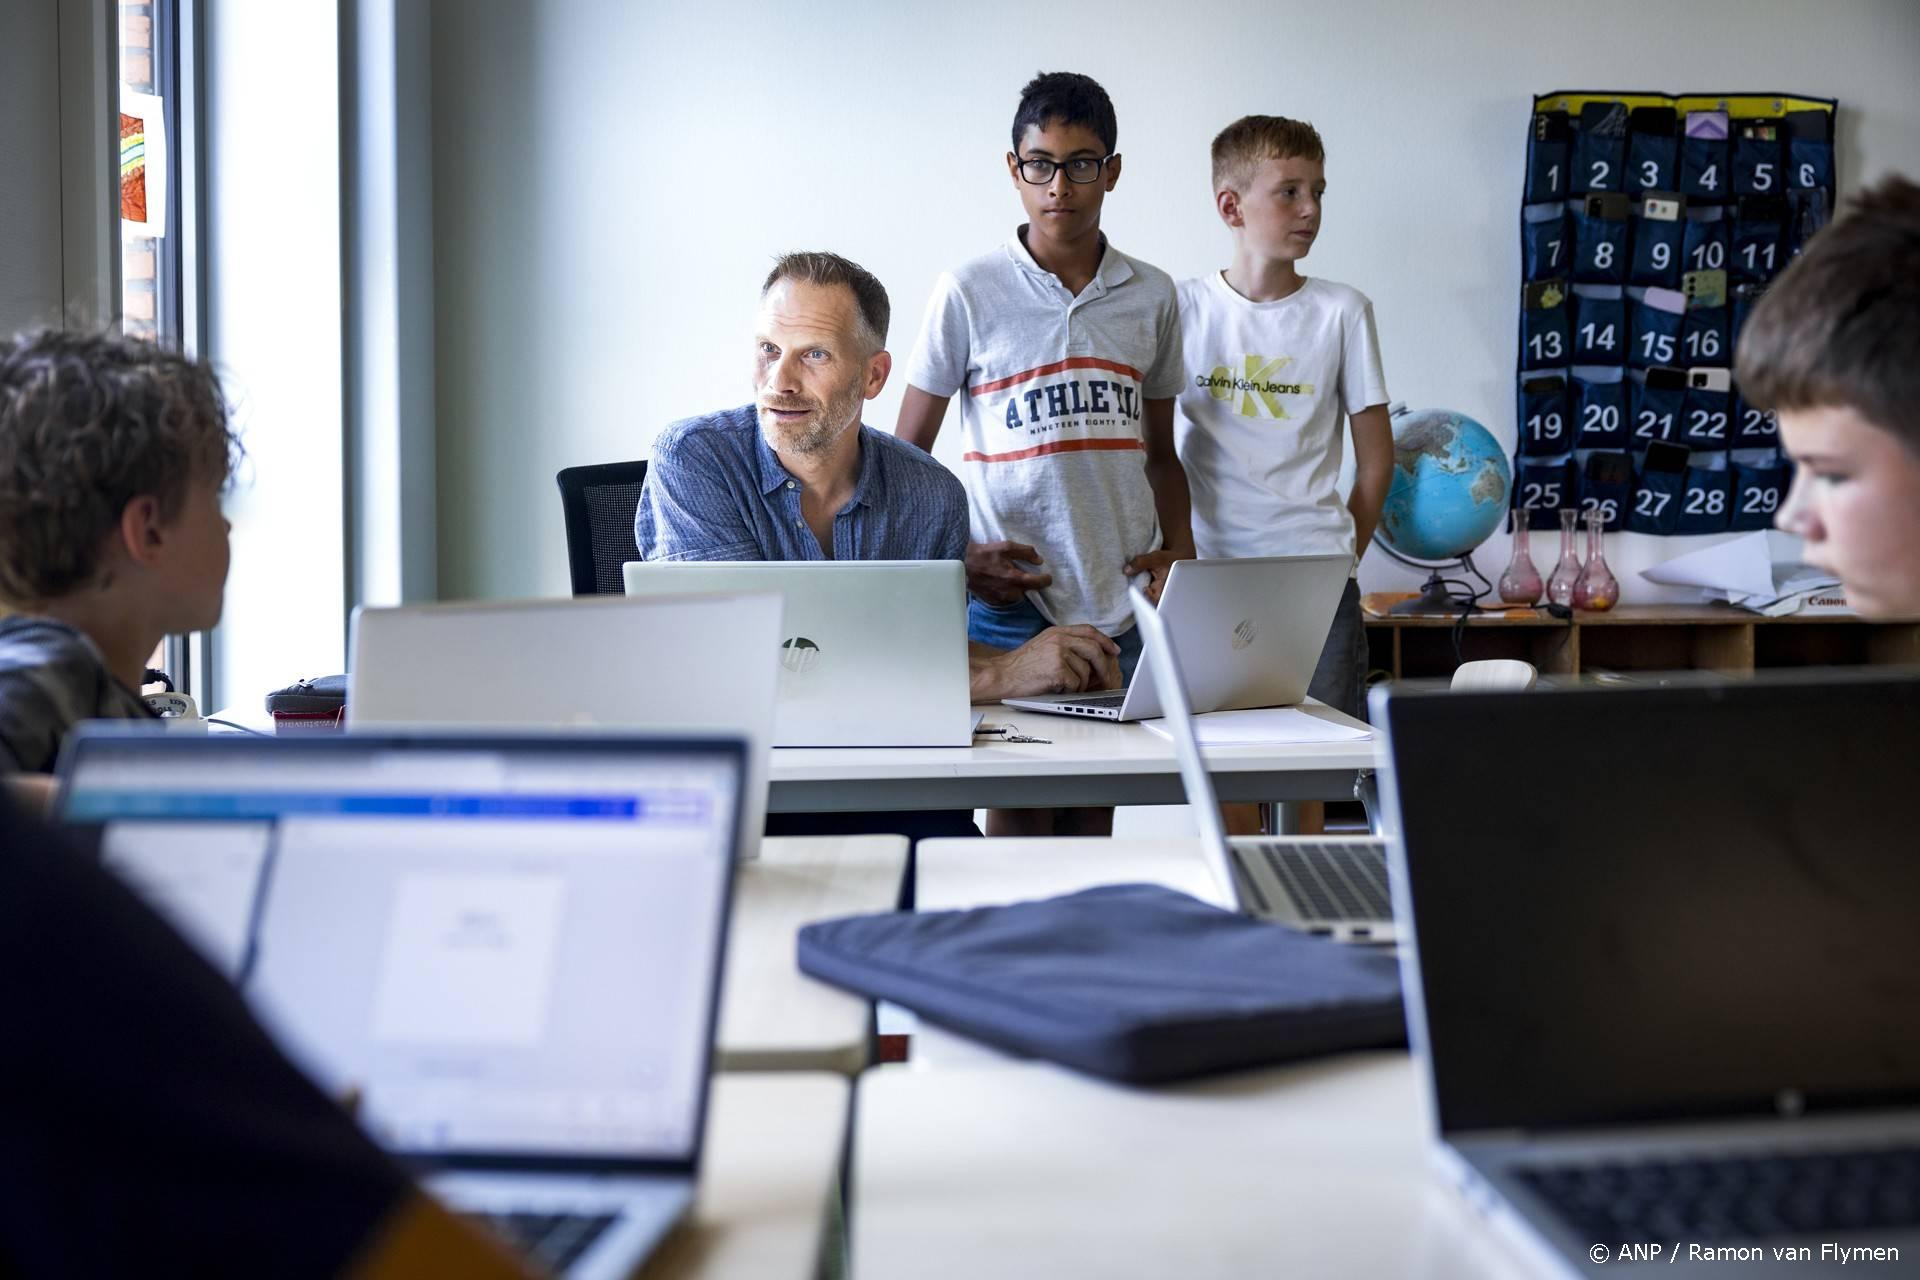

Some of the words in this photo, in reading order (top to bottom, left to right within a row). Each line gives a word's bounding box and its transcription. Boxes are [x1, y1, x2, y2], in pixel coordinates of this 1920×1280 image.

[1547, 165, 1558, 191] 1
[1590, 161, 1609, 188] 2
[1640, 161, 1659, 187] 3
[1699, 165, 1717, 190] 4
[1753, 164, 1773, 191] 5
[1799, 163, 1815, 188] 6
[1547, 241, 1561, 267] 7
[1594, 242, 1614, 269] 8
[1651, 242, 1671, 270] 9
[1692, 241, 1724, 269] 10
[1742, 243, 1776, 269] 11
[1529, 331, 1563, 360] 13
[1581, 322, 1616, 351] 14
[1640, 331, 1676, 363] 15
[1686, 329, 1719, 357] 16
[1195, 375, 1231, 389] Calvin
[1233, 377, 1261, 392] Klein
[1262, 380, 1301, 394] Jeans
[1030, 420, 1079, 435] NINETEEN
[1085, 418, 1116, 427] EIGHTY
[1527, 412, 1562, 440] 19
[1583, 404, 1619, 432] 20
[1635, 410, 1673, 440] 21
[1688, 410, 1727, 438] 22
[1742, 409, 1777, 435] 23
[1524, 483, 1561, 509] 25
[1581, 497, 1618, 523] 26
[1635, 489, 1672, 517] 27
[1685, 487, 1725, 514] 28
[1742, 487, 1778, 513] 29
[783, 636, 819, 673] hp
